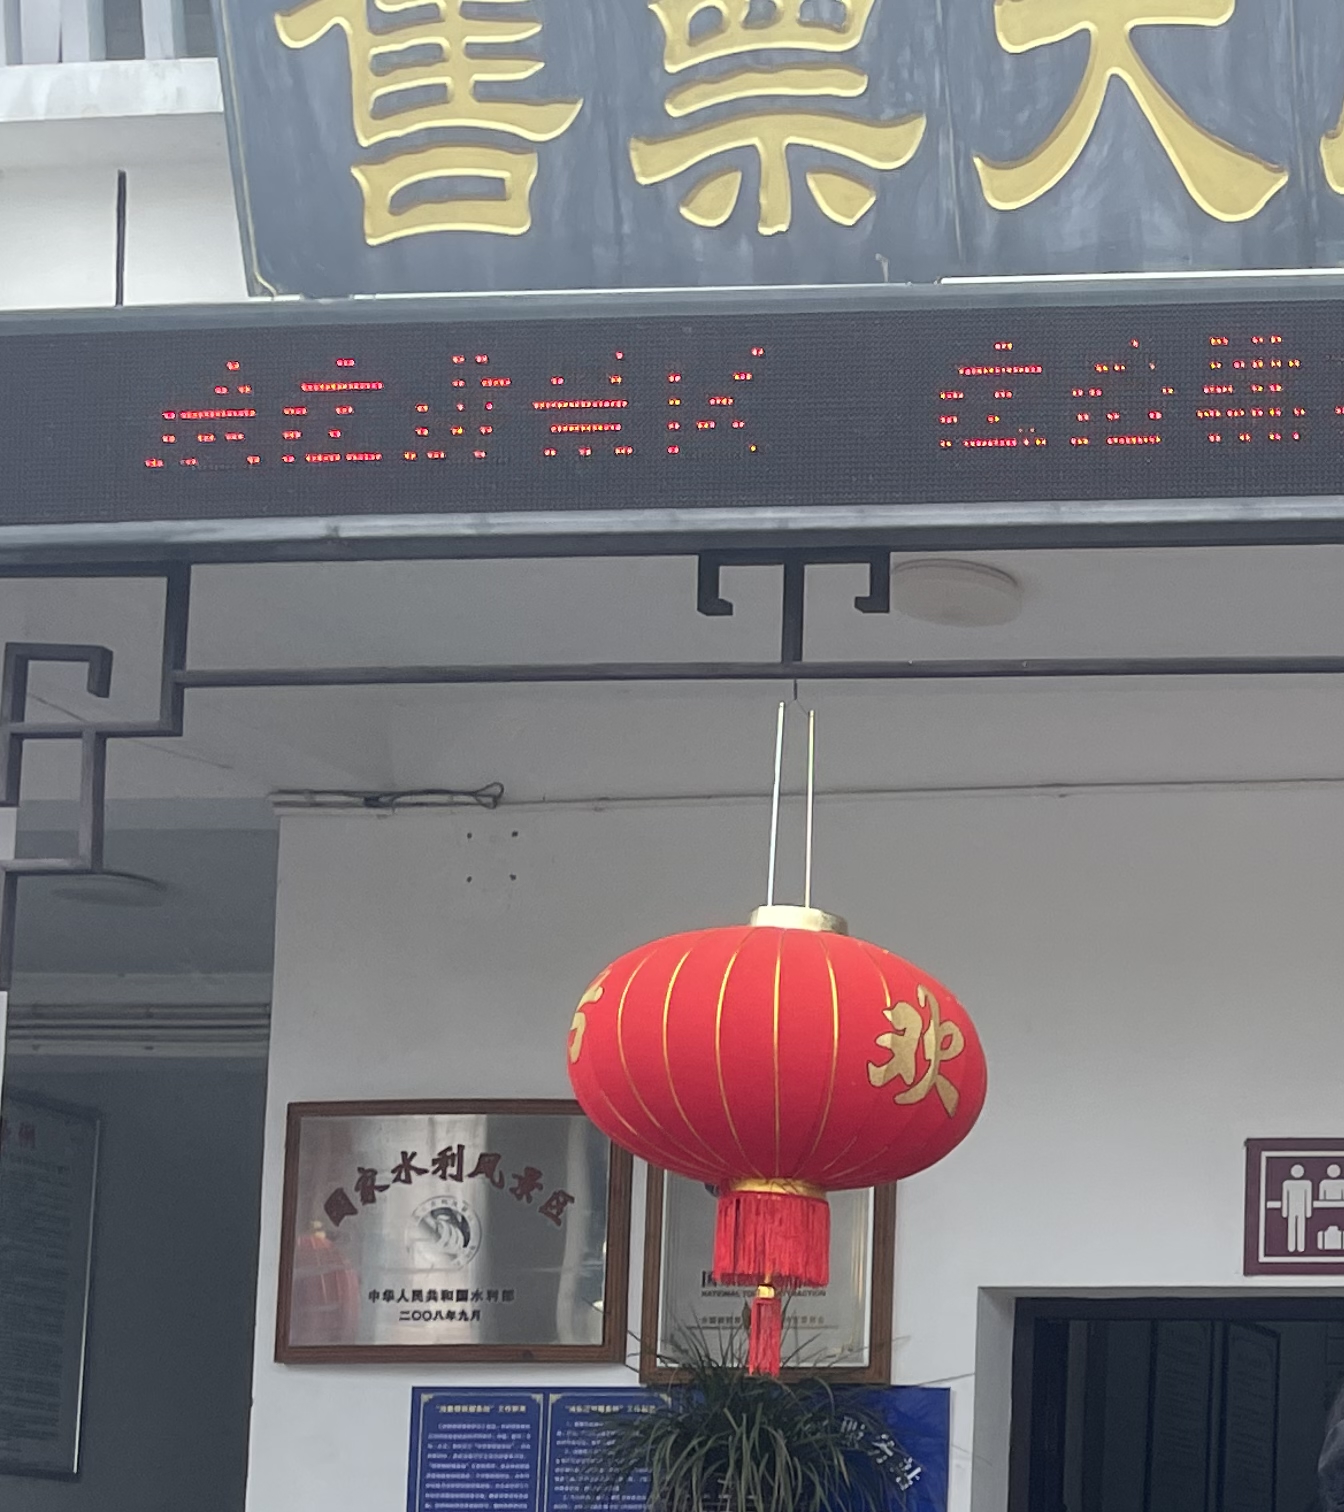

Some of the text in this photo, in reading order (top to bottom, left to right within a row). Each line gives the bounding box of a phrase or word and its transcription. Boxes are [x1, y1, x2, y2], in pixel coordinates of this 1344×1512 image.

[324, 1143, 576, 1227] 国家水利风景区
[367, 1288, 516, 1303] 中华人民共和国水利部
